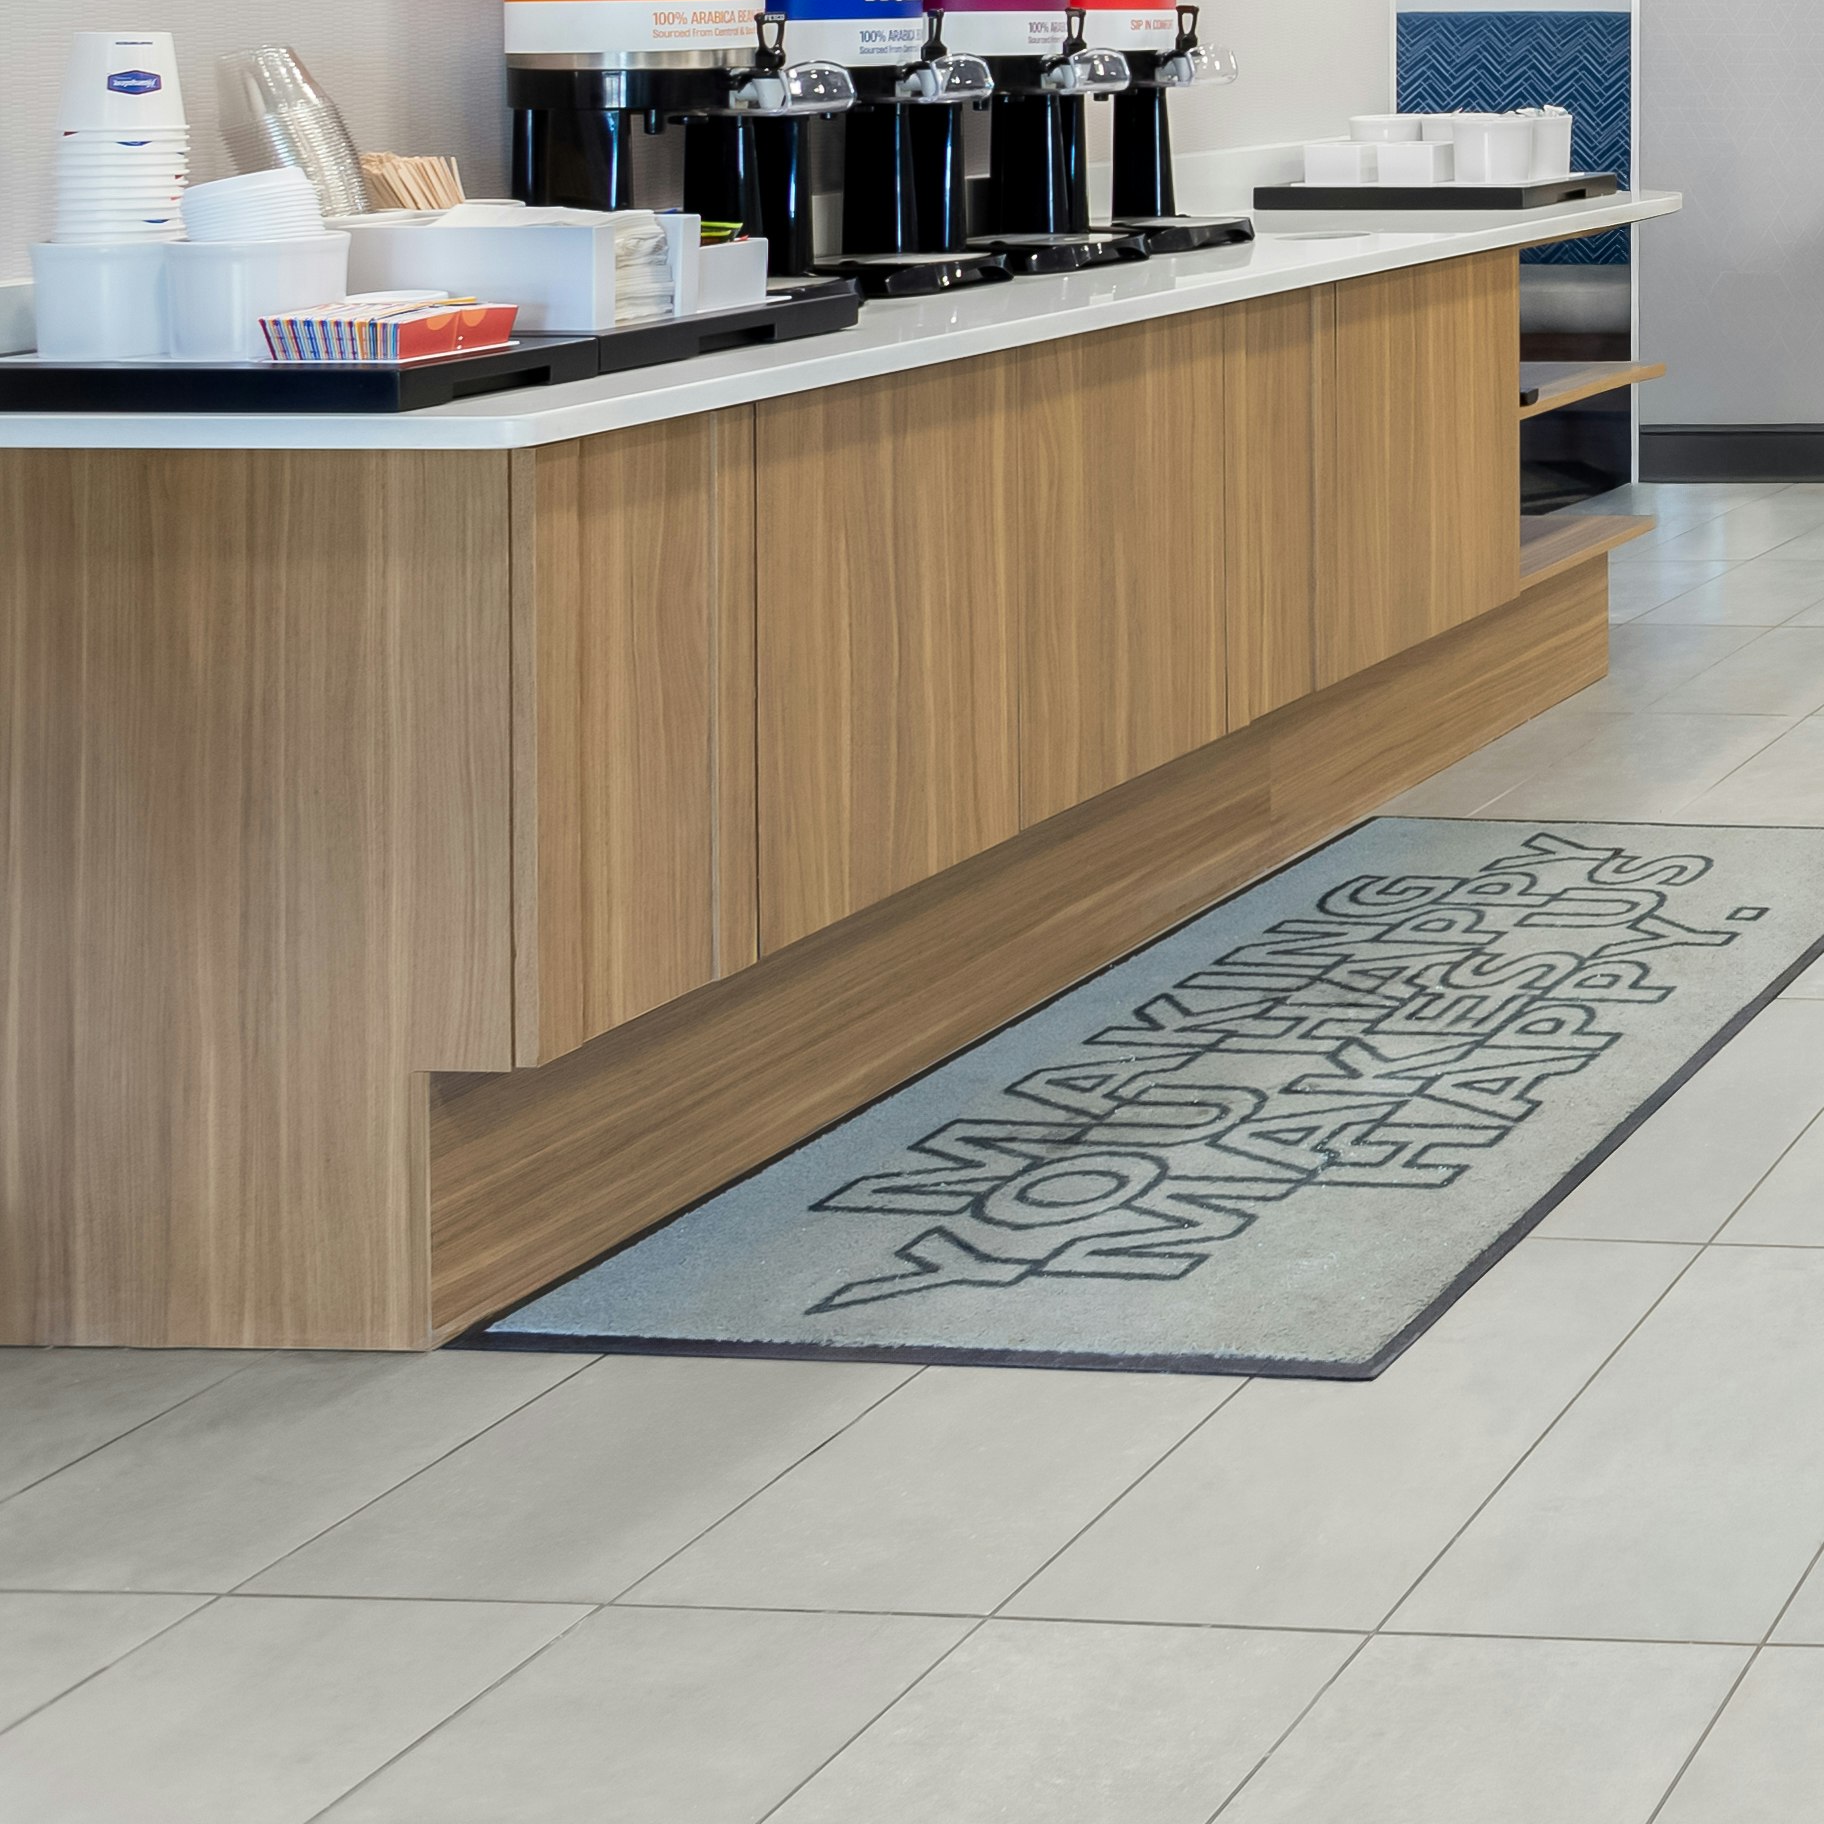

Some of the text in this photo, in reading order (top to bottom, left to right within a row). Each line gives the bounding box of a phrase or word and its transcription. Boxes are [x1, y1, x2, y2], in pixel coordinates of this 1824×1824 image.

[652, 12, 688, 26] 100%
[690, 10, 736, 25] ARABICA
[859, 30, 886, 43] 100%
[803, 831, 1625, 1316] YOU HAPPY
[808, 873, 1473, 1216] MAKING
[1033, 853, 1715, 1280] MAKES US
